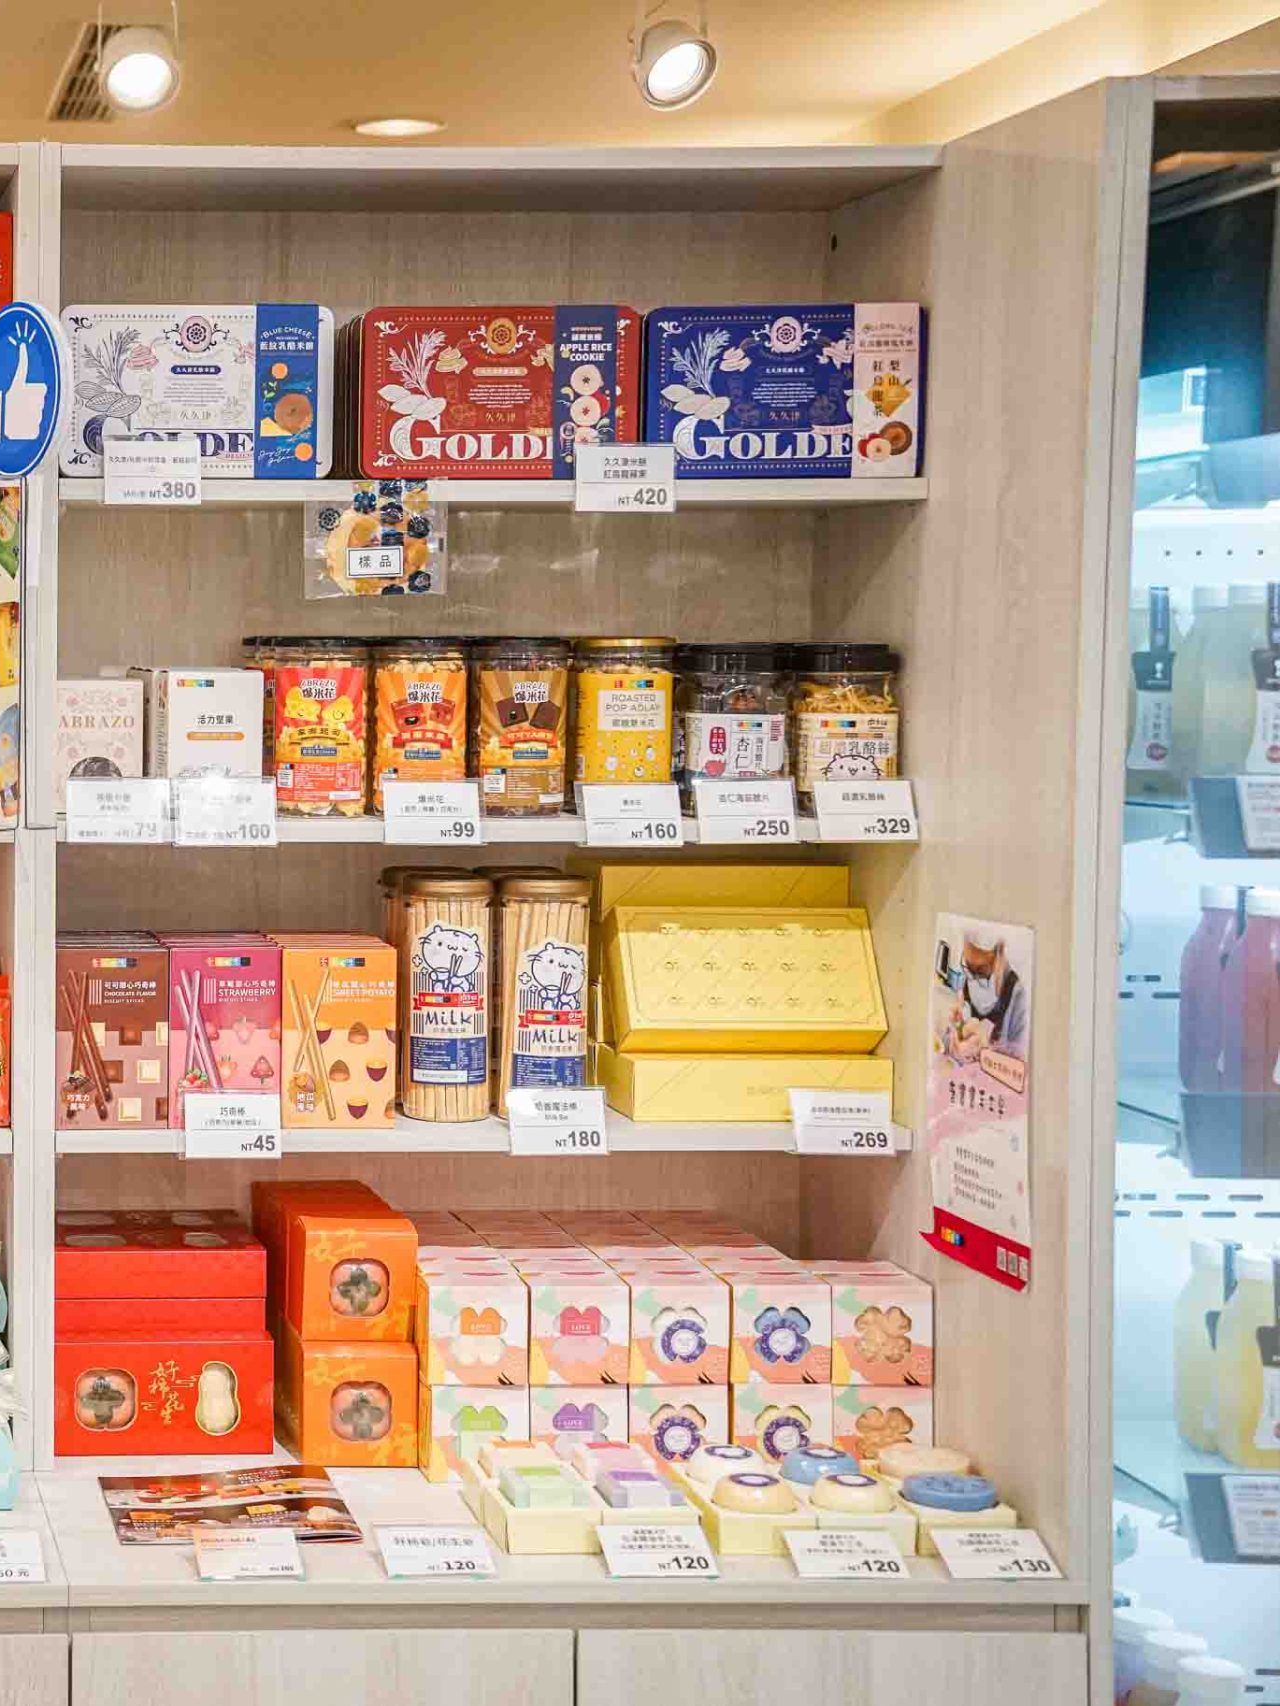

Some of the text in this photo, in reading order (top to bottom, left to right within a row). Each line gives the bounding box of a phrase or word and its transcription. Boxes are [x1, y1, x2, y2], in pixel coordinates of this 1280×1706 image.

[263, 326, 312, 339] BLUE CHEESE
[591, 343, 612, 351] RICE
[390, 415, 553, 461] GOLD
[358, 554, 392, 569] 樣品
[606, 704, 627, 713] POP
[197, 714, 234, 725] 活力堅果
[735, 736, 750, 769] 杏仁
[218, 988, 276, 996] STRAWBERRY
[241, 1135, 275, 1151] NT45
[554, 1130, 601, 1148] NT180
[841, 1131, 888, 1148] NT269
[444, 1560, 477, 1571] 120
